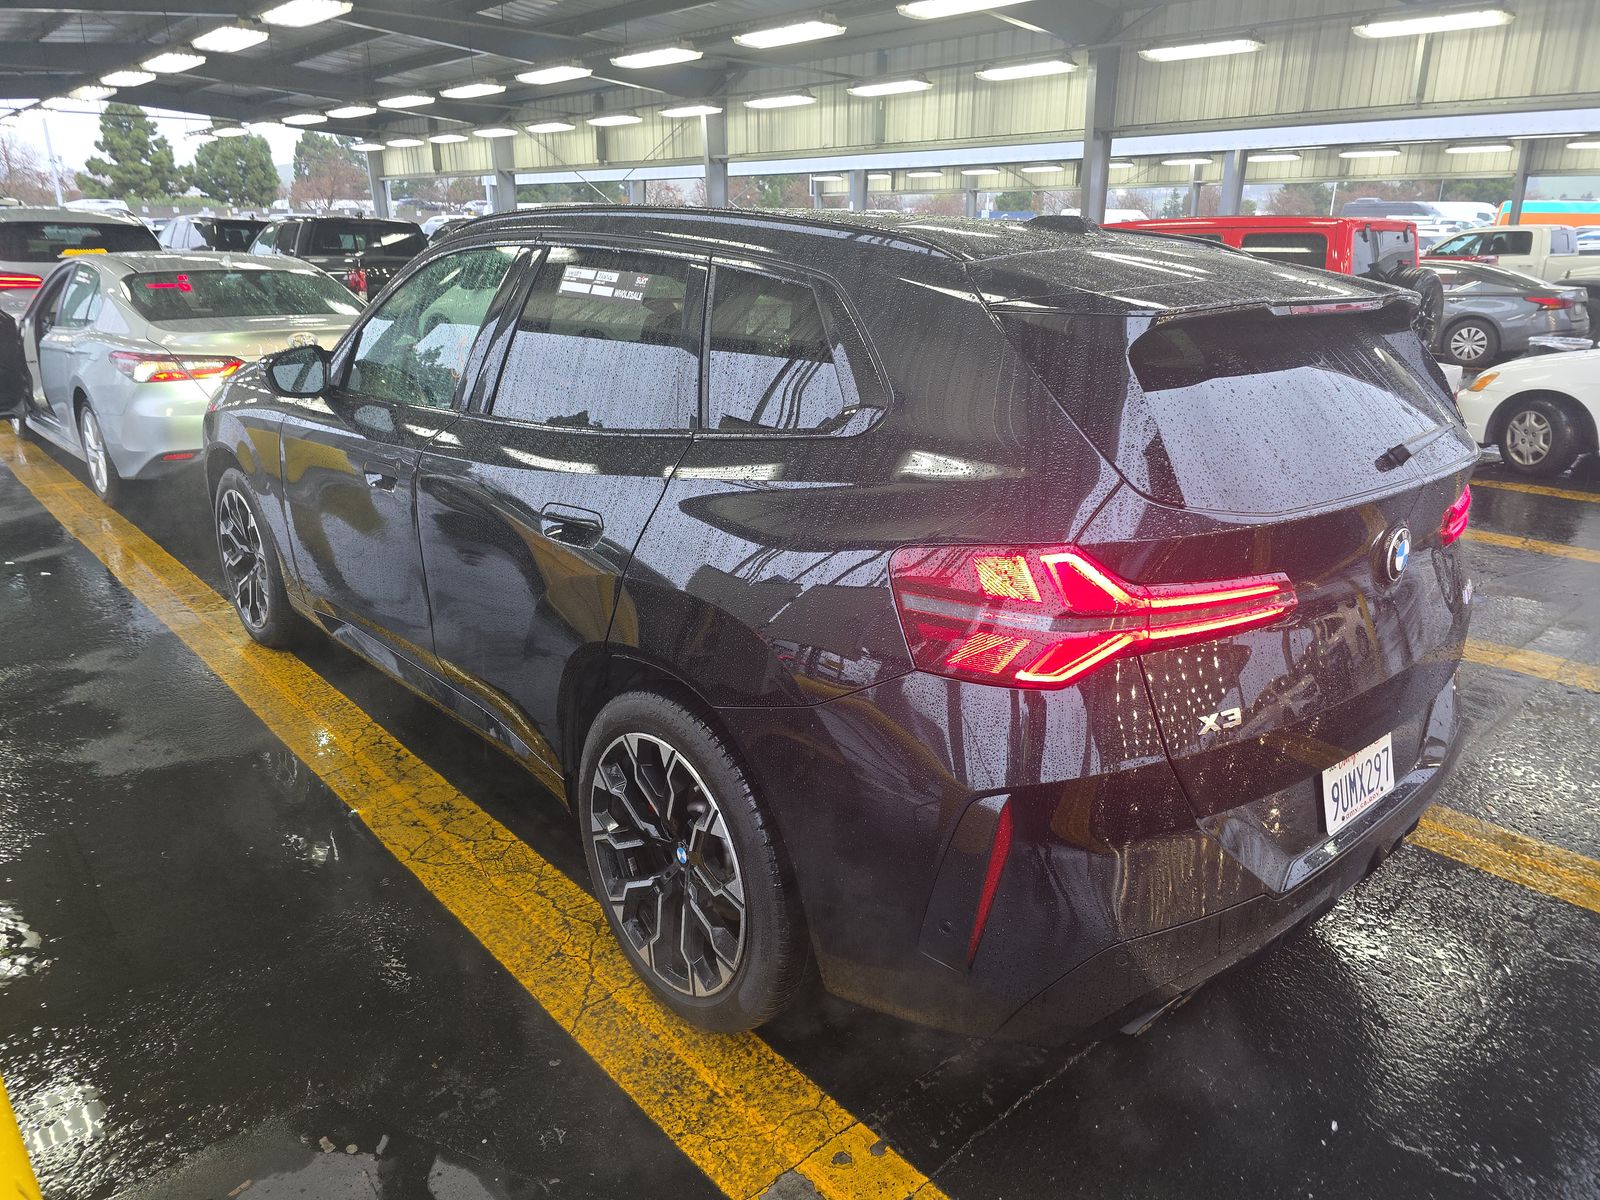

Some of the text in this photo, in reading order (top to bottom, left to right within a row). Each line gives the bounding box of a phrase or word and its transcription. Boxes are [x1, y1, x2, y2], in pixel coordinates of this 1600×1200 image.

[614, 289, 643, 301] WHOLESALE
[1197, 707, 1241, 736] X3
[1331, 745, 1389, 822] 9UMX297
